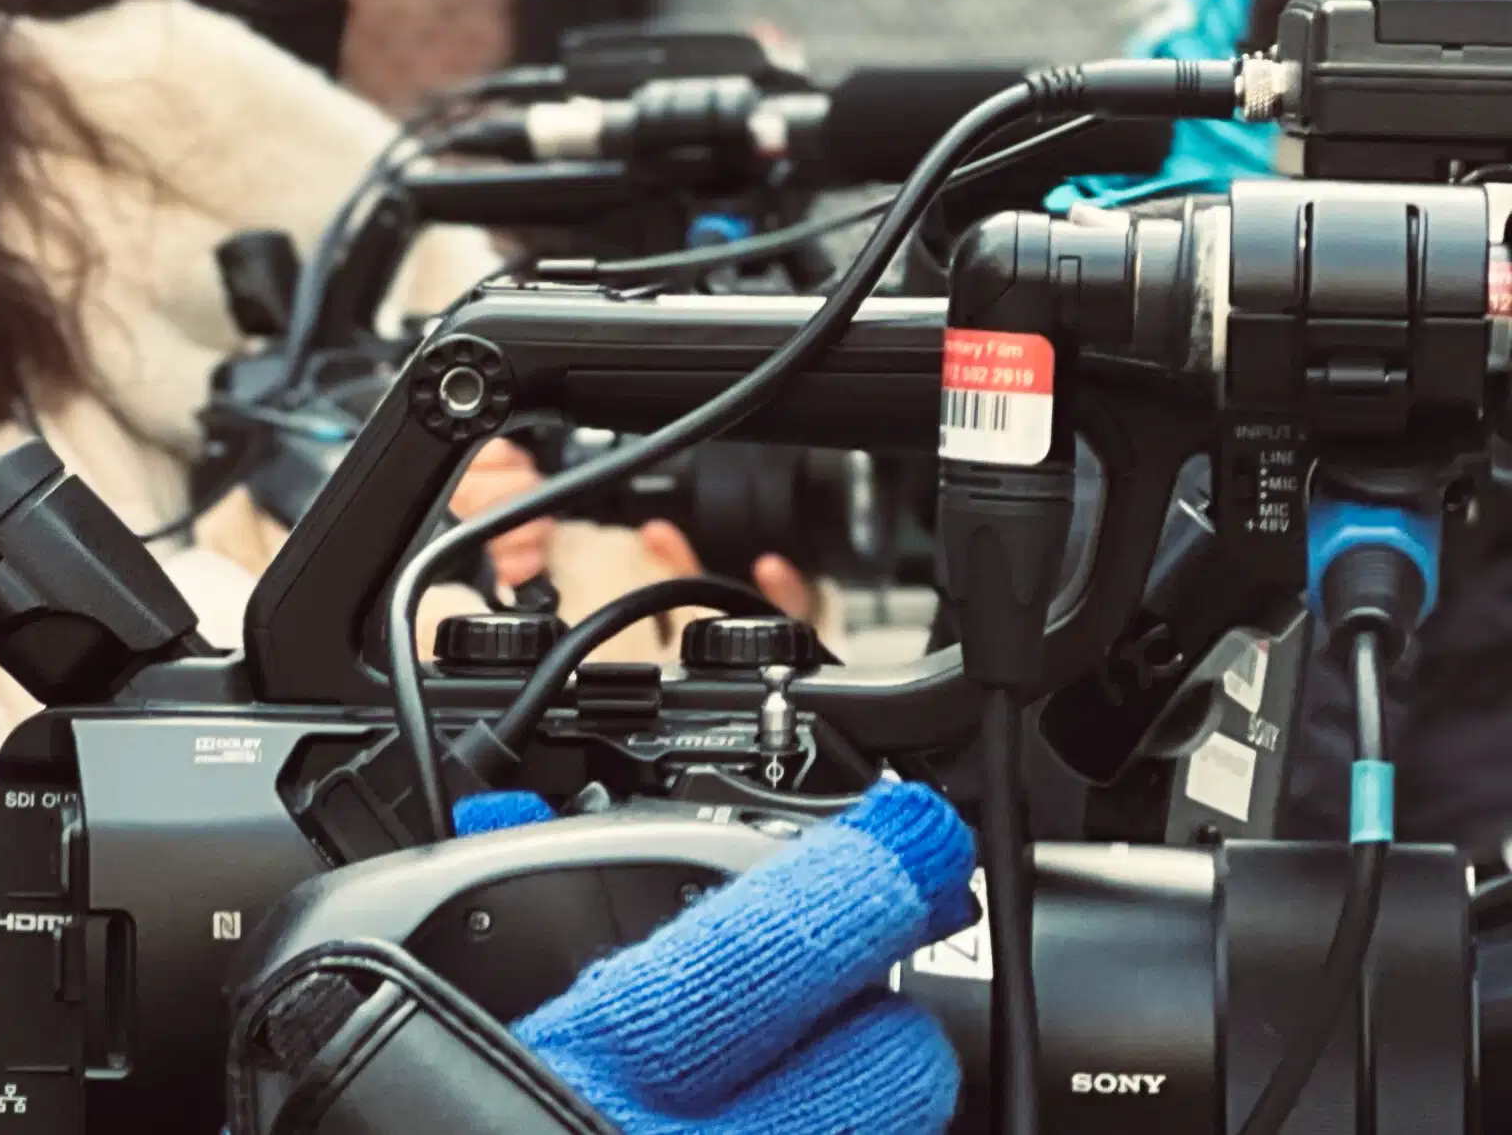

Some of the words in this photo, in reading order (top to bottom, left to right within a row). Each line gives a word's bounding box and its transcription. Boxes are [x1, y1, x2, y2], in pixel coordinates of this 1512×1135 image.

[1269, 476, 1298, 491] MIC
[1260, 503, 1289, 518] MIC
[4, 790, 36, 808] SDI
[1071, 1072, 1167, 1095] SONY
